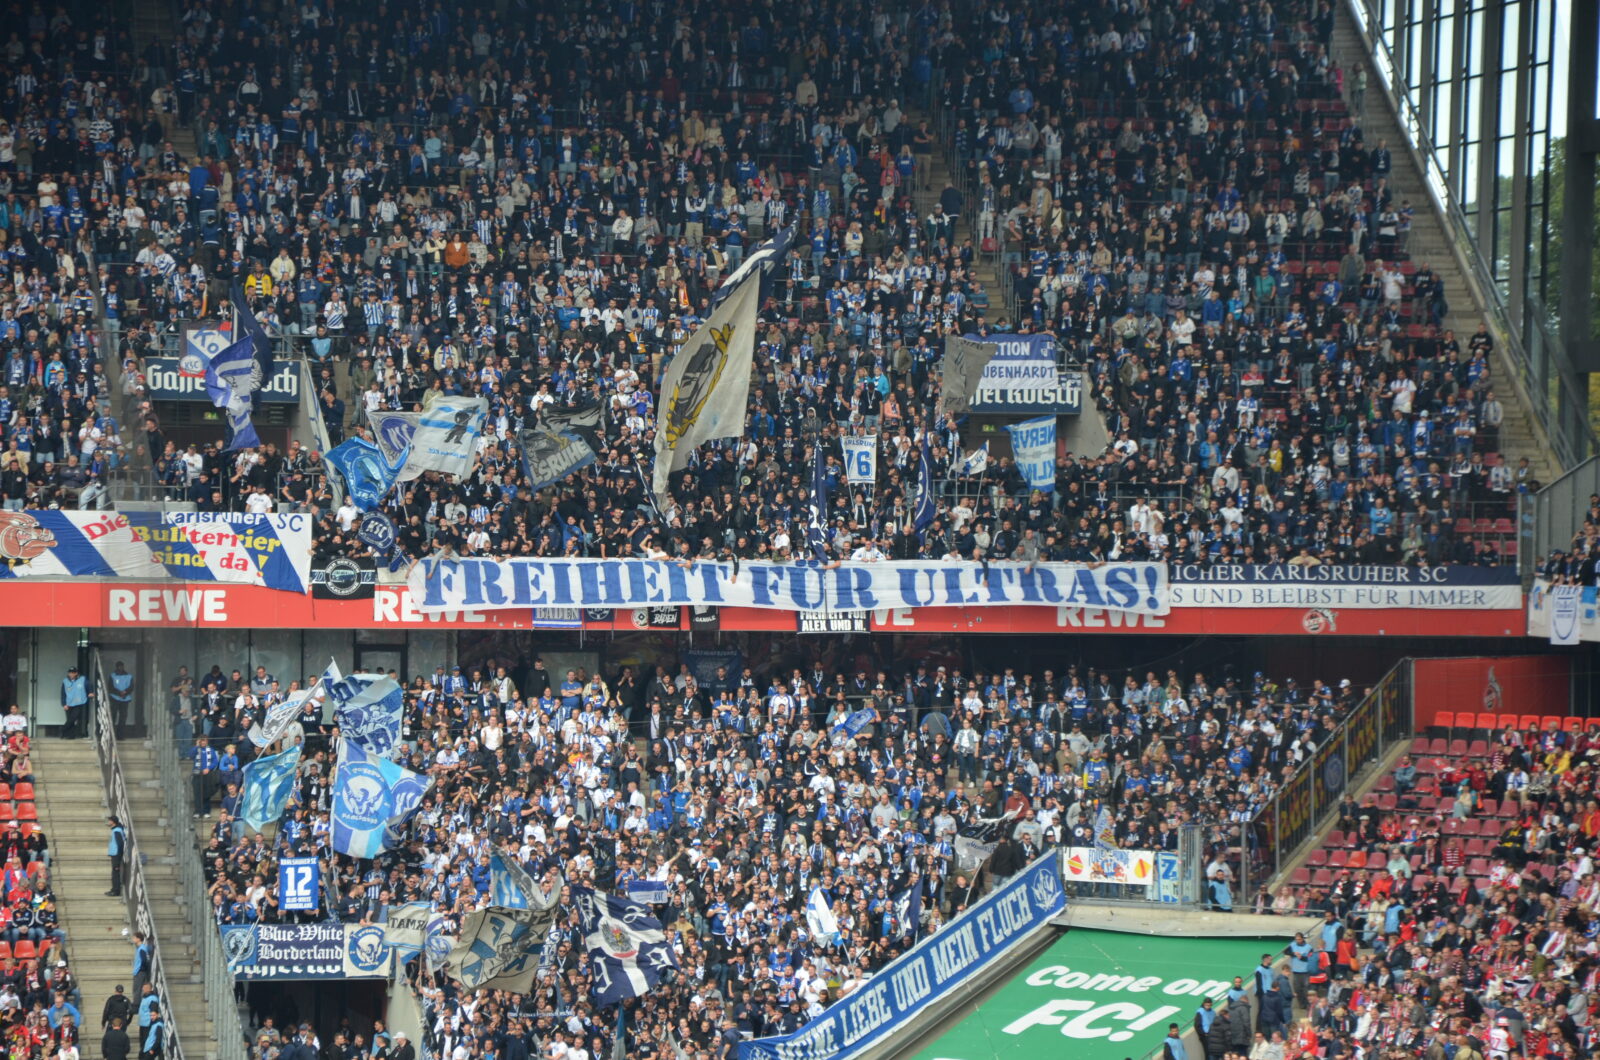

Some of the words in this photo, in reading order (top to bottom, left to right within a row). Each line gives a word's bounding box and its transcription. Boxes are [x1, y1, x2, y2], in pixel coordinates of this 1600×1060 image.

[985, 341, 1031, 356] TION
[82, 513, 130, 541] Die
[277, 513, 304, 533] SC
[131, 526, 282, 553] Bullterrier
[151, 545, 207, 568] sind
[219, 551, 249, 572] da
[422, 558, 732, 606] FREIHEIT
[750, 558, 879, 609] FÜR
[896, 565, 1160, 609] ULTRAS!
[1171, 564, 1246, 581] ICHER
[1254, 564, 1410, 582] KARLSRUHER
[1418, 565, 1449, 583] SC
[109, 589, 227, 622] REWE
[1192, 588, 1243, 604] UND
[1252, 588, 1354, 604] BLEIBST
[1355, 586, 1400, 605] FÜR
[1409, 589, 1487, 606] IMMER
[801, 619, 827, 632] ALEX
[830, 619, 852, 631] UND
[854, 619, 867, 631] M.
[284, 866, 313, 897] 12
[257, 923, 344, 943] Blue-White
[257, 943, 344, 962] Borderland
[840, 980, 893, 1047] LIEBE
[890, 955, 932, 1013] UND
[929, 930, 980, 985] MEIN
[977, 882, 1034, 952] FLUCH
[1025, 964, 1163, 993] Come
[1001, 998, 1182, 1042] FC!
